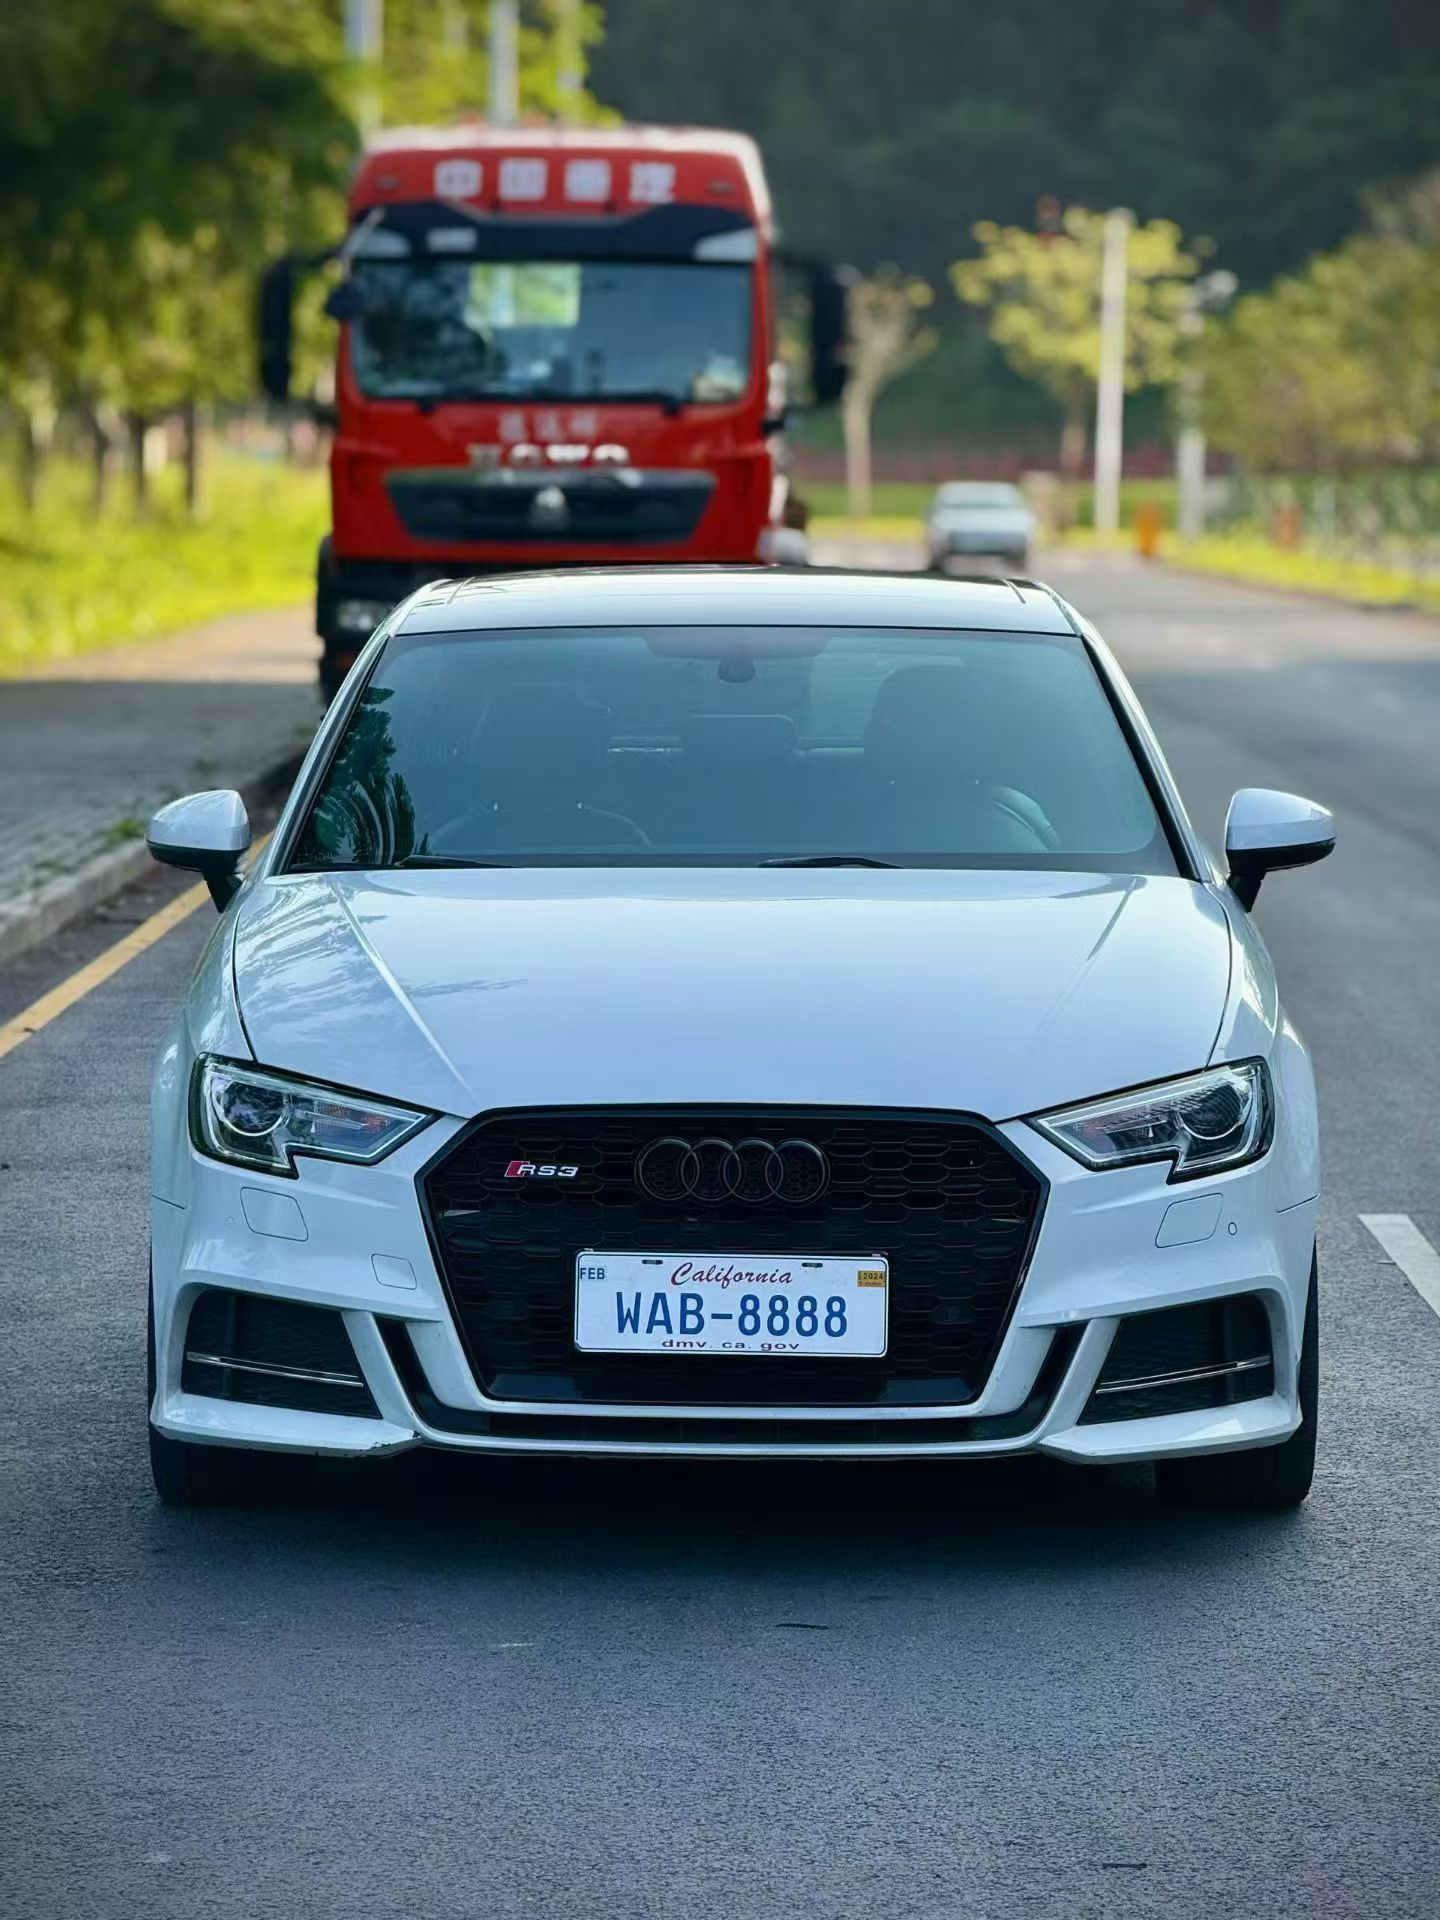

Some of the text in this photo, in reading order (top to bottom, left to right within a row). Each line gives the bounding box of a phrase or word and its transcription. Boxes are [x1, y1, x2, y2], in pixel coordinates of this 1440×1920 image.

[516, 1164, 579, 1177] RS3
[580, 1267, 606, 1280] FEB
[671, 1262, 793, 1289] California
[863, 1272, 884, 1280] 2024
[616, 1292, 848, 1338] WAB-8888
